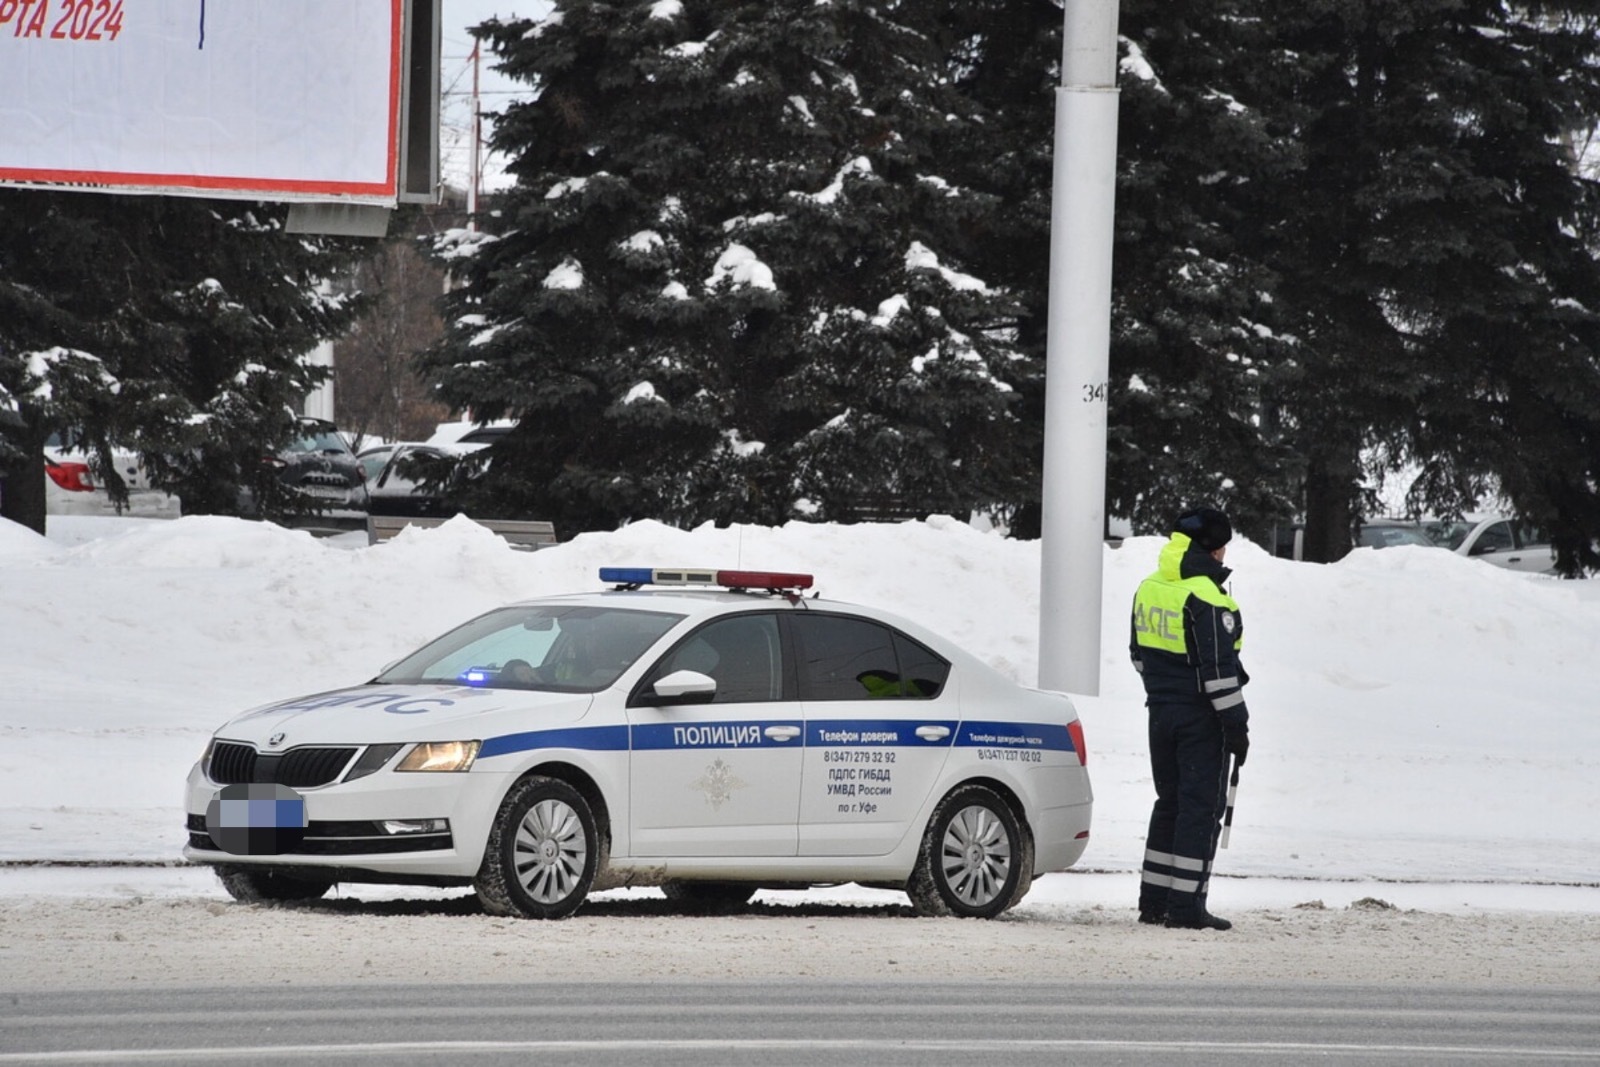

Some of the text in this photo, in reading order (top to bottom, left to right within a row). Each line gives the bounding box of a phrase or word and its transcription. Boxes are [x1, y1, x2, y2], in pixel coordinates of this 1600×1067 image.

[50, 0, 124, 41] 2024
[1135, 602, 1179, 640] ДПС
[674, 725, 761, 747] ПОЛИЦИЯ
[819, 729, 898, 744] Телефон доверия
[871, 752, 883, 763] 32
[884, 752, 896, 763] 92
[1020, 750, 1030, 762] 02
[1031, 751, 1042, 763] 02
[828, 768, 891, 782] ПДПС ГИБДД
[827, 783, 892, 797] УМВД России
[838, 803, 849, 813] по
[858, 801, 877, 815] Уфе
